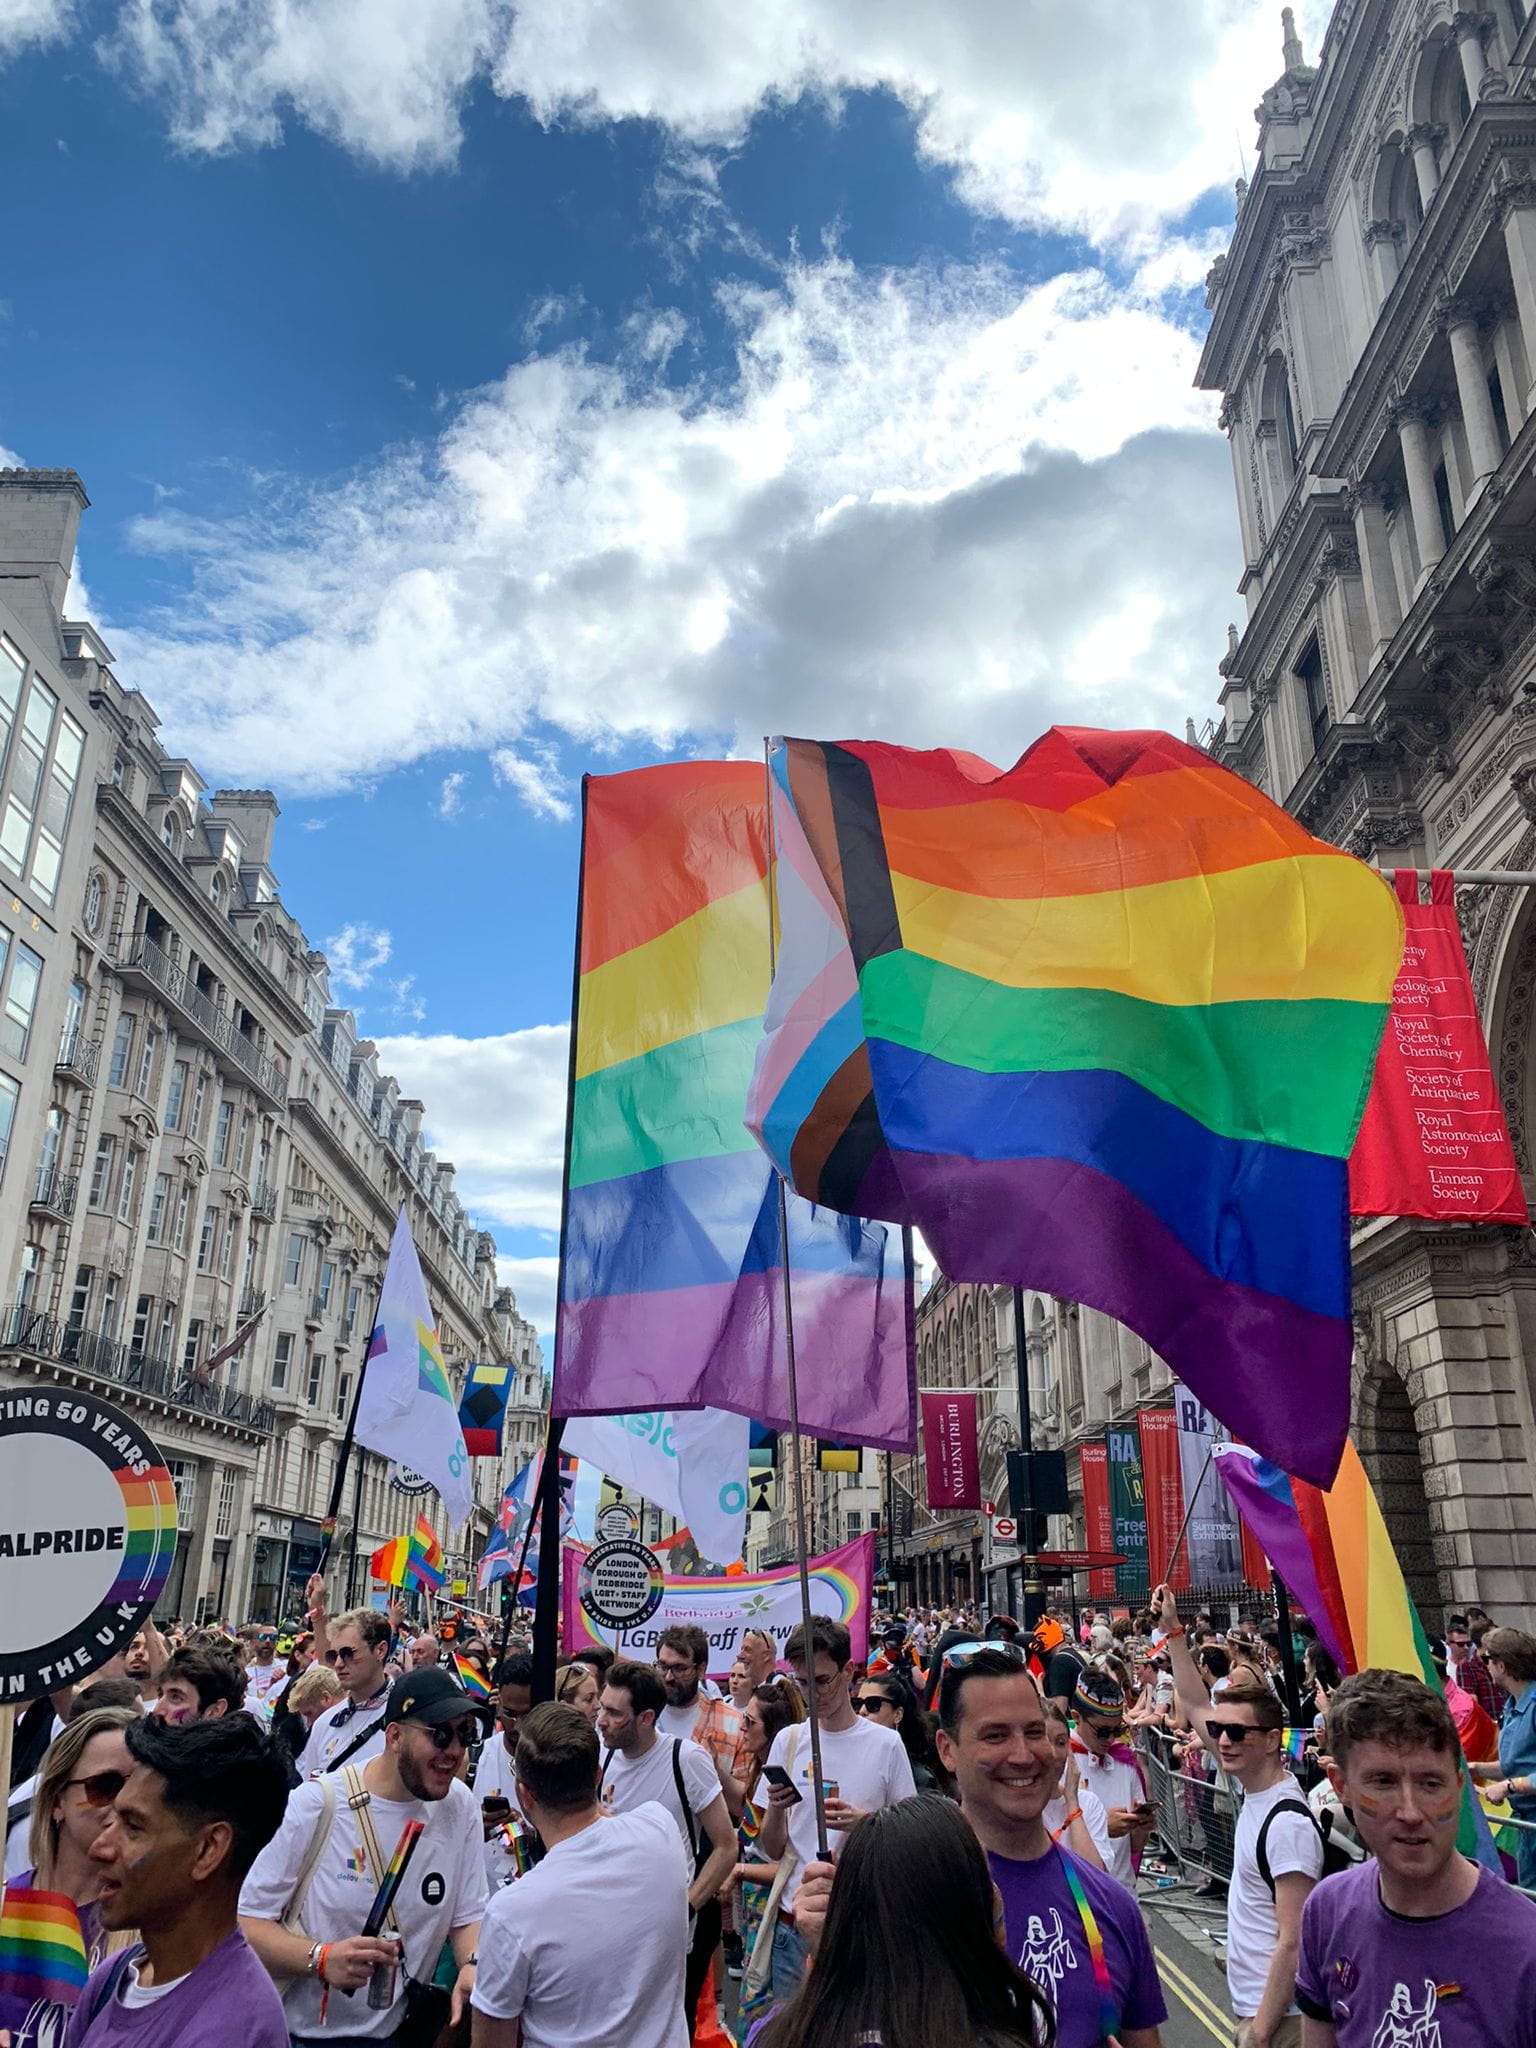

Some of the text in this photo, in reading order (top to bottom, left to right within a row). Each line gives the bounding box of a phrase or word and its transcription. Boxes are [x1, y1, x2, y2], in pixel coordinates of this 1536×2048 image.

[1392, 1016, 1429, 1034] Royal
[1395, 1030, 1453, 1047] Society of
[1399, 1043, 1463, 1063] Chemistry
[1405, 1069, 1463, 1087] Society of
[1410, 1083, 1480, 1102] Antiquaries
[1415, 1111, 1454, 1129] Royal
[1420, 1126, 1504, 1143] Astronomical
[1422, 1140, 1469, 1159] Society
[1428, 1169, 1484, 1185] Linnean
[1431, 1184, 1479, 1204] Society
[1142, 1422, 1169, 1430] House
[56, 1401, 88, 1424] 50
[91, 1413, 151, 1477] YEARS
[1109, 1433, 1137, 1462] RA
[947, 1404, 965, 1498] BURLINGTON
[1115, 1517, 1147, 1532] Free
[1191, 1521, 1232, 1531] Summer
[1192, 1530, 1240, 1540] Exhibition
[586, 1542, 631, 1567] CELEBRATING
[641, 1549, 658, 1571] YEARS
[606, 1559, 640, 1569] LONDON
[596, 1569, 648, 1579] BOROUGH OF
[598, 1579, 645, 1589] REDBRIDGE
[621, 1591, 647, 1599] STAFF
[599, 1600, 641, 1609] NETWORK
[591, 1610, 612, 1627] PRIDE
[626, 1617, 641, 1627] THE
[38, 1646, 93, 1686] THE
[95, 1595, 144, 1646] U.K.
